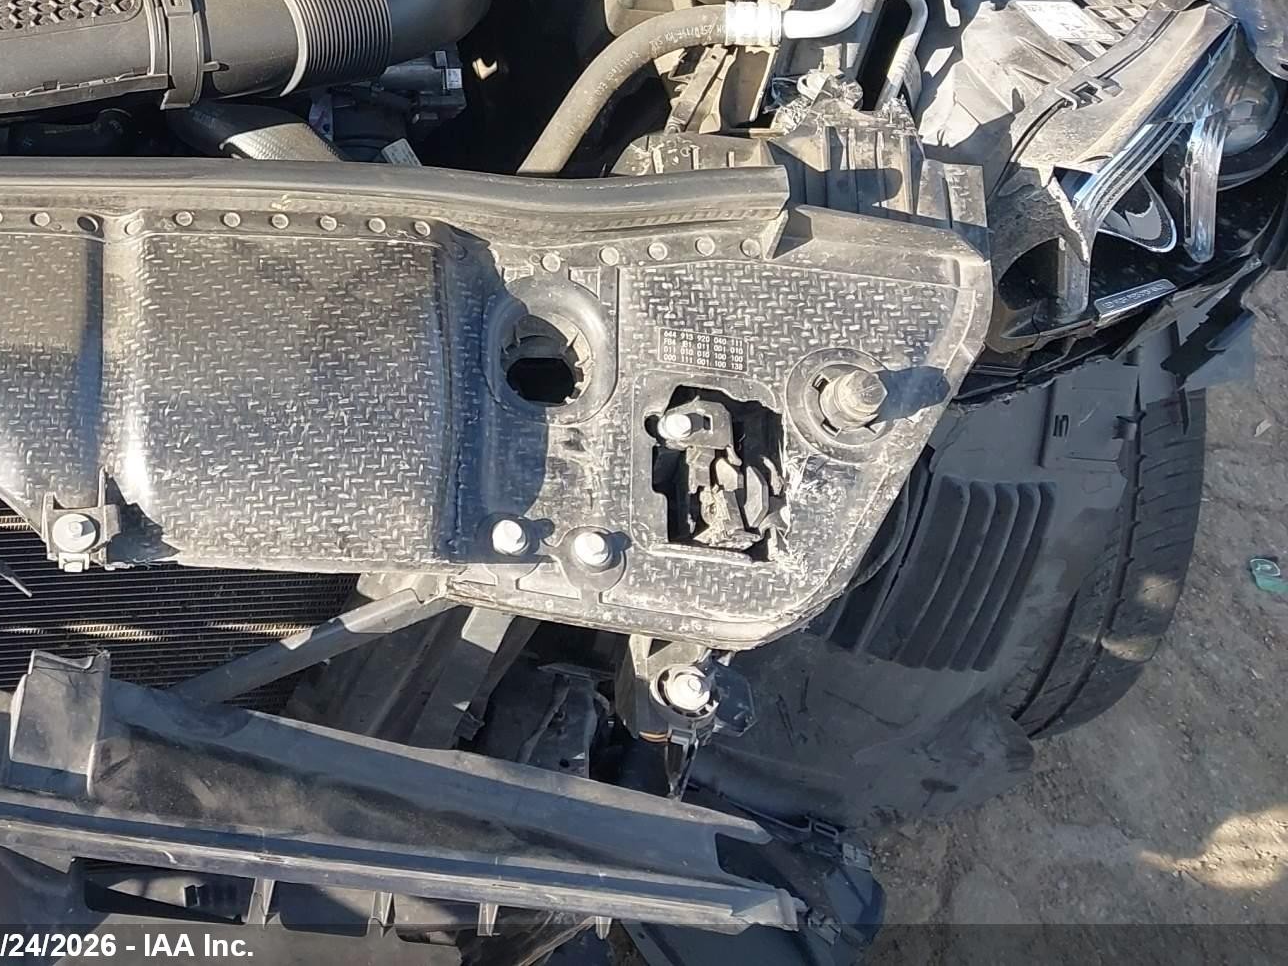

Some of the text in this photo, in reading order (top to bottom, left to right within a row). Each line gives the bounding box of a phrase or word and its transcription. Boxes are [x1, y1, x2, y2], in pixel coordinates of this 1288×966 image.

[696, 335, 711, 343] 920
[731, 338, 743, 347] 111
[663, 346, 676, 354] 011
[680, 347, 694, 356] 010
[714, 352, 727, 361] 100
[731, 354, 744, 363] 100
[696, 342, 710, 351] 011
[729, 347, 744, 355] 010
[663, 353, 677, 362] 000
[681, 355, 693, 364] 111
[714, 360, 727, 369] 100
